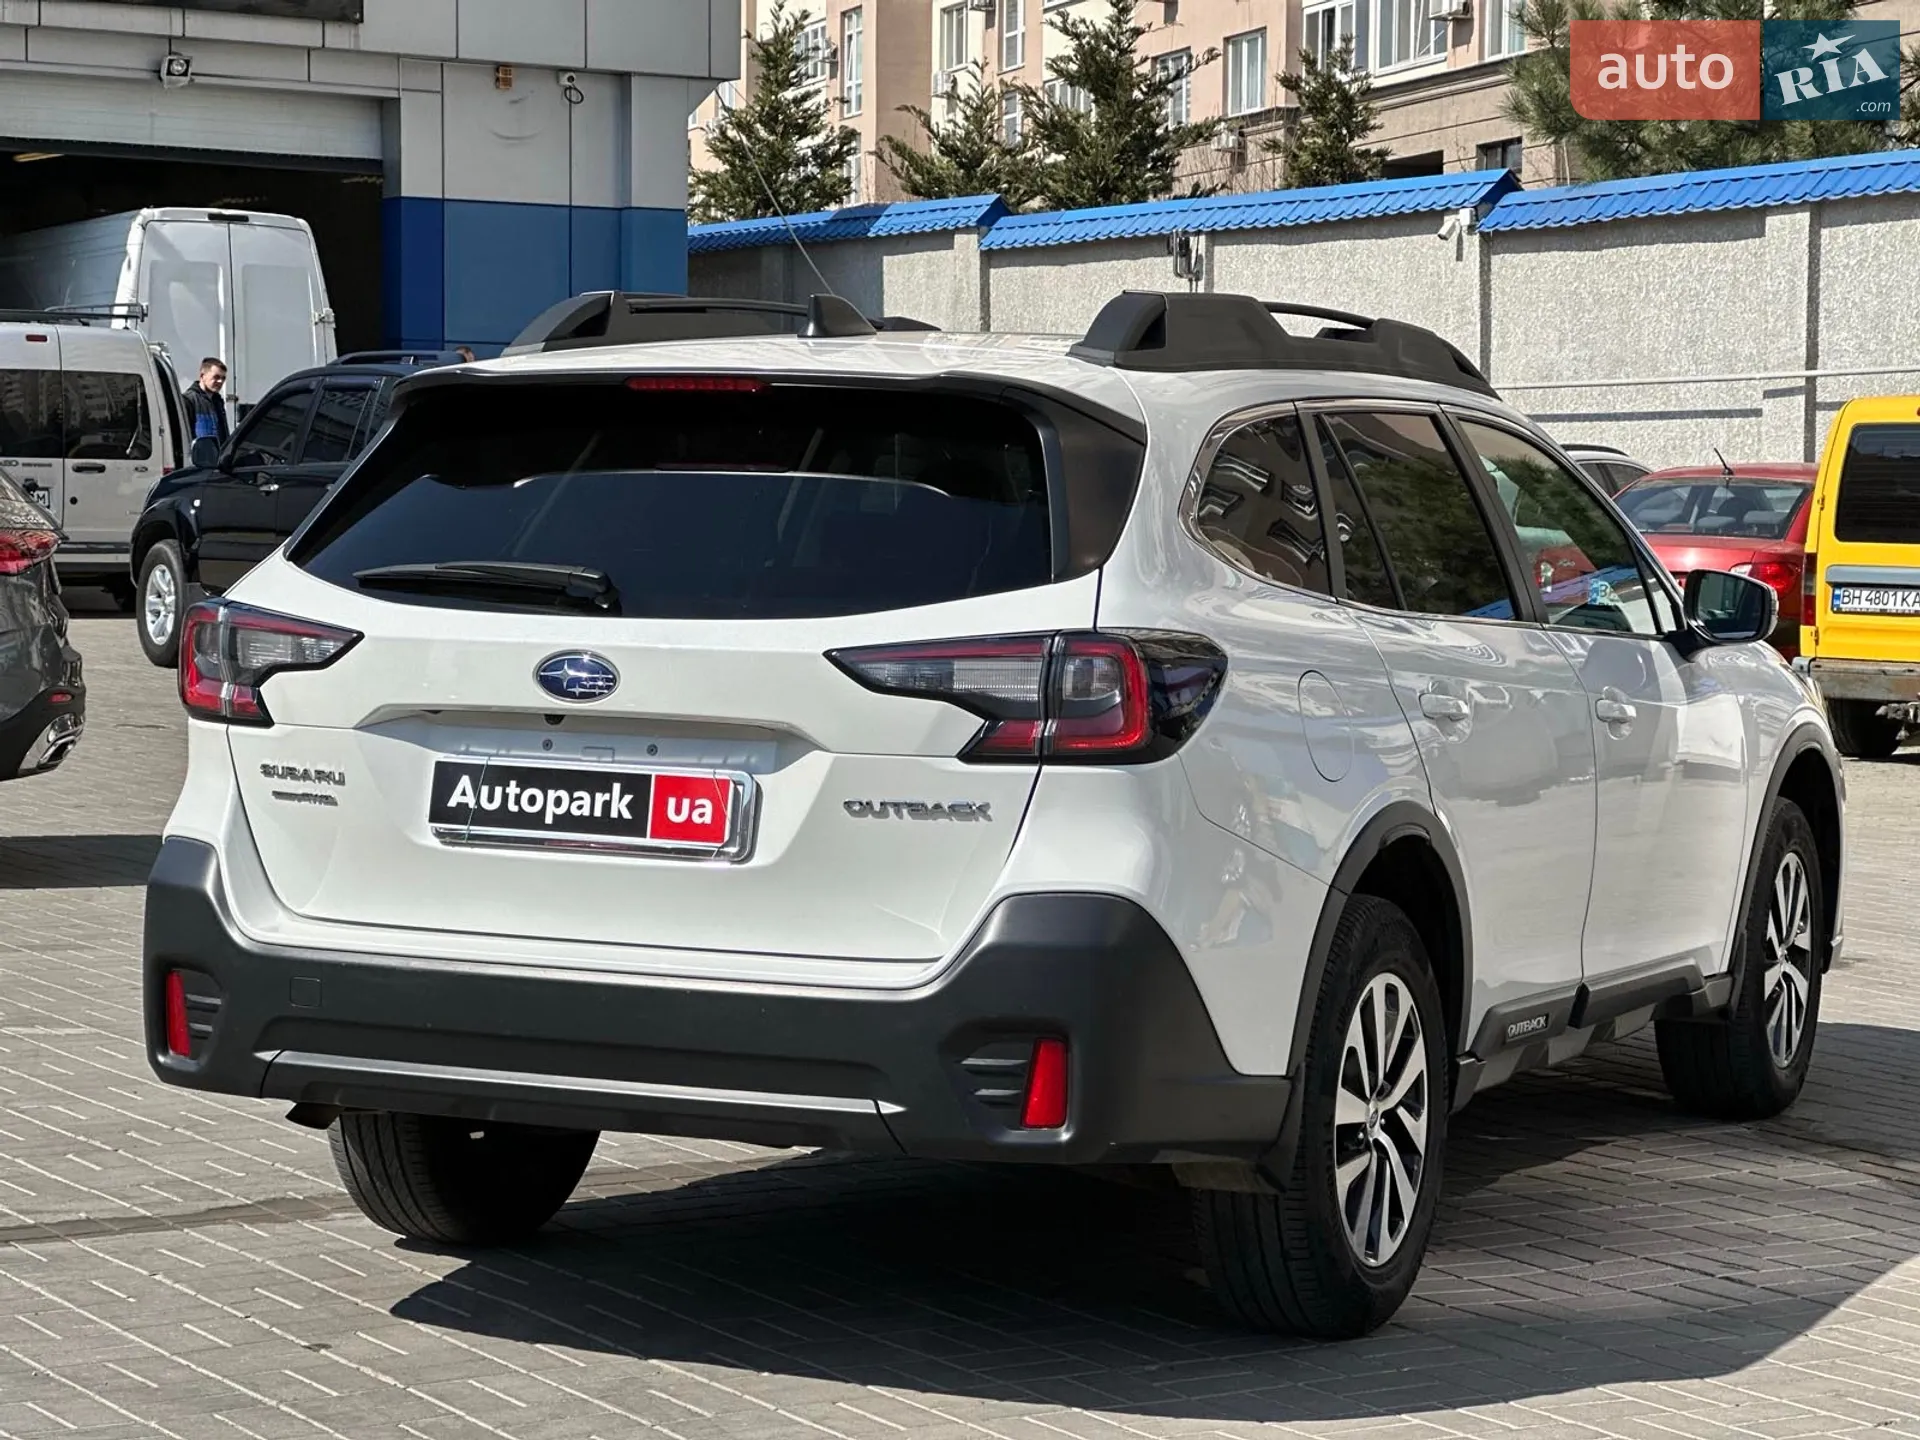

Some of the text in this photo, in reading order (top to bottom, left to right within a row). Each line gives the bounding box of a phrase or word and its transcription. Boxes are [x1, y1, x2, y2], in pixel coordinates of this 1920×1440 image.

[1841, 589, 1862, 605] BH
[1865, 590, 1898, 607] 4801
[260, 764, 346, 786] SUBARU
[447, 774, 713, 825] Autopark ua
[843, 800, 993, 822] OUTBACK
[1508, 1016, 1546, 1037] OUTBACK
